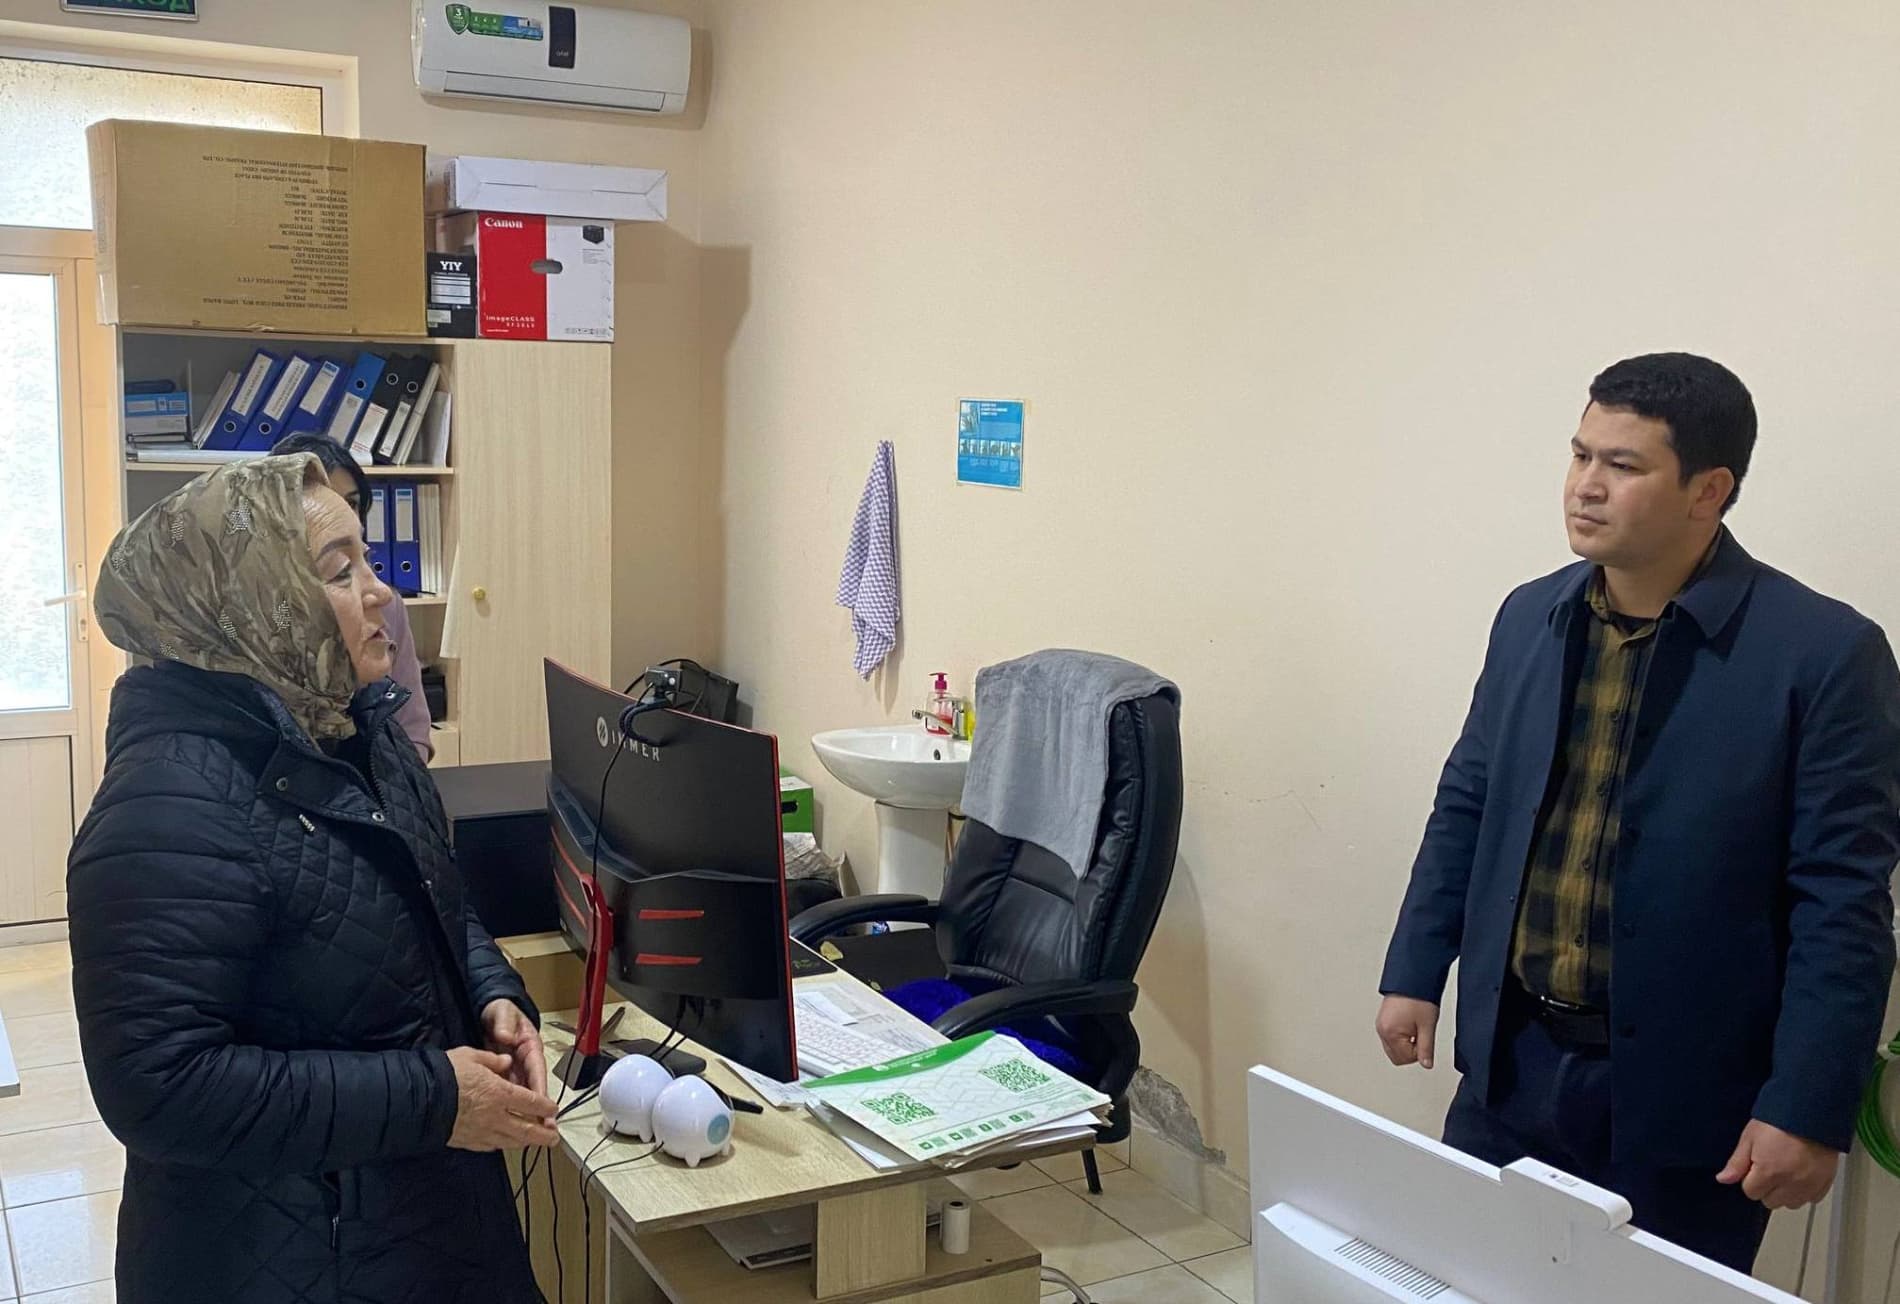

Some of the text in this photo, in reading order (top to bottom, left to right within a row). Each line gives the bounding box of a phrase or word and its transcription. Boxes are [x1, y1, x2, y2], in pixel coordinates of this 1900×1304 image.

[484, 217, 523, 230] Canon
[440, 260, 463, 272] YIY
[486, 315, 535, 324] imageCLASS
